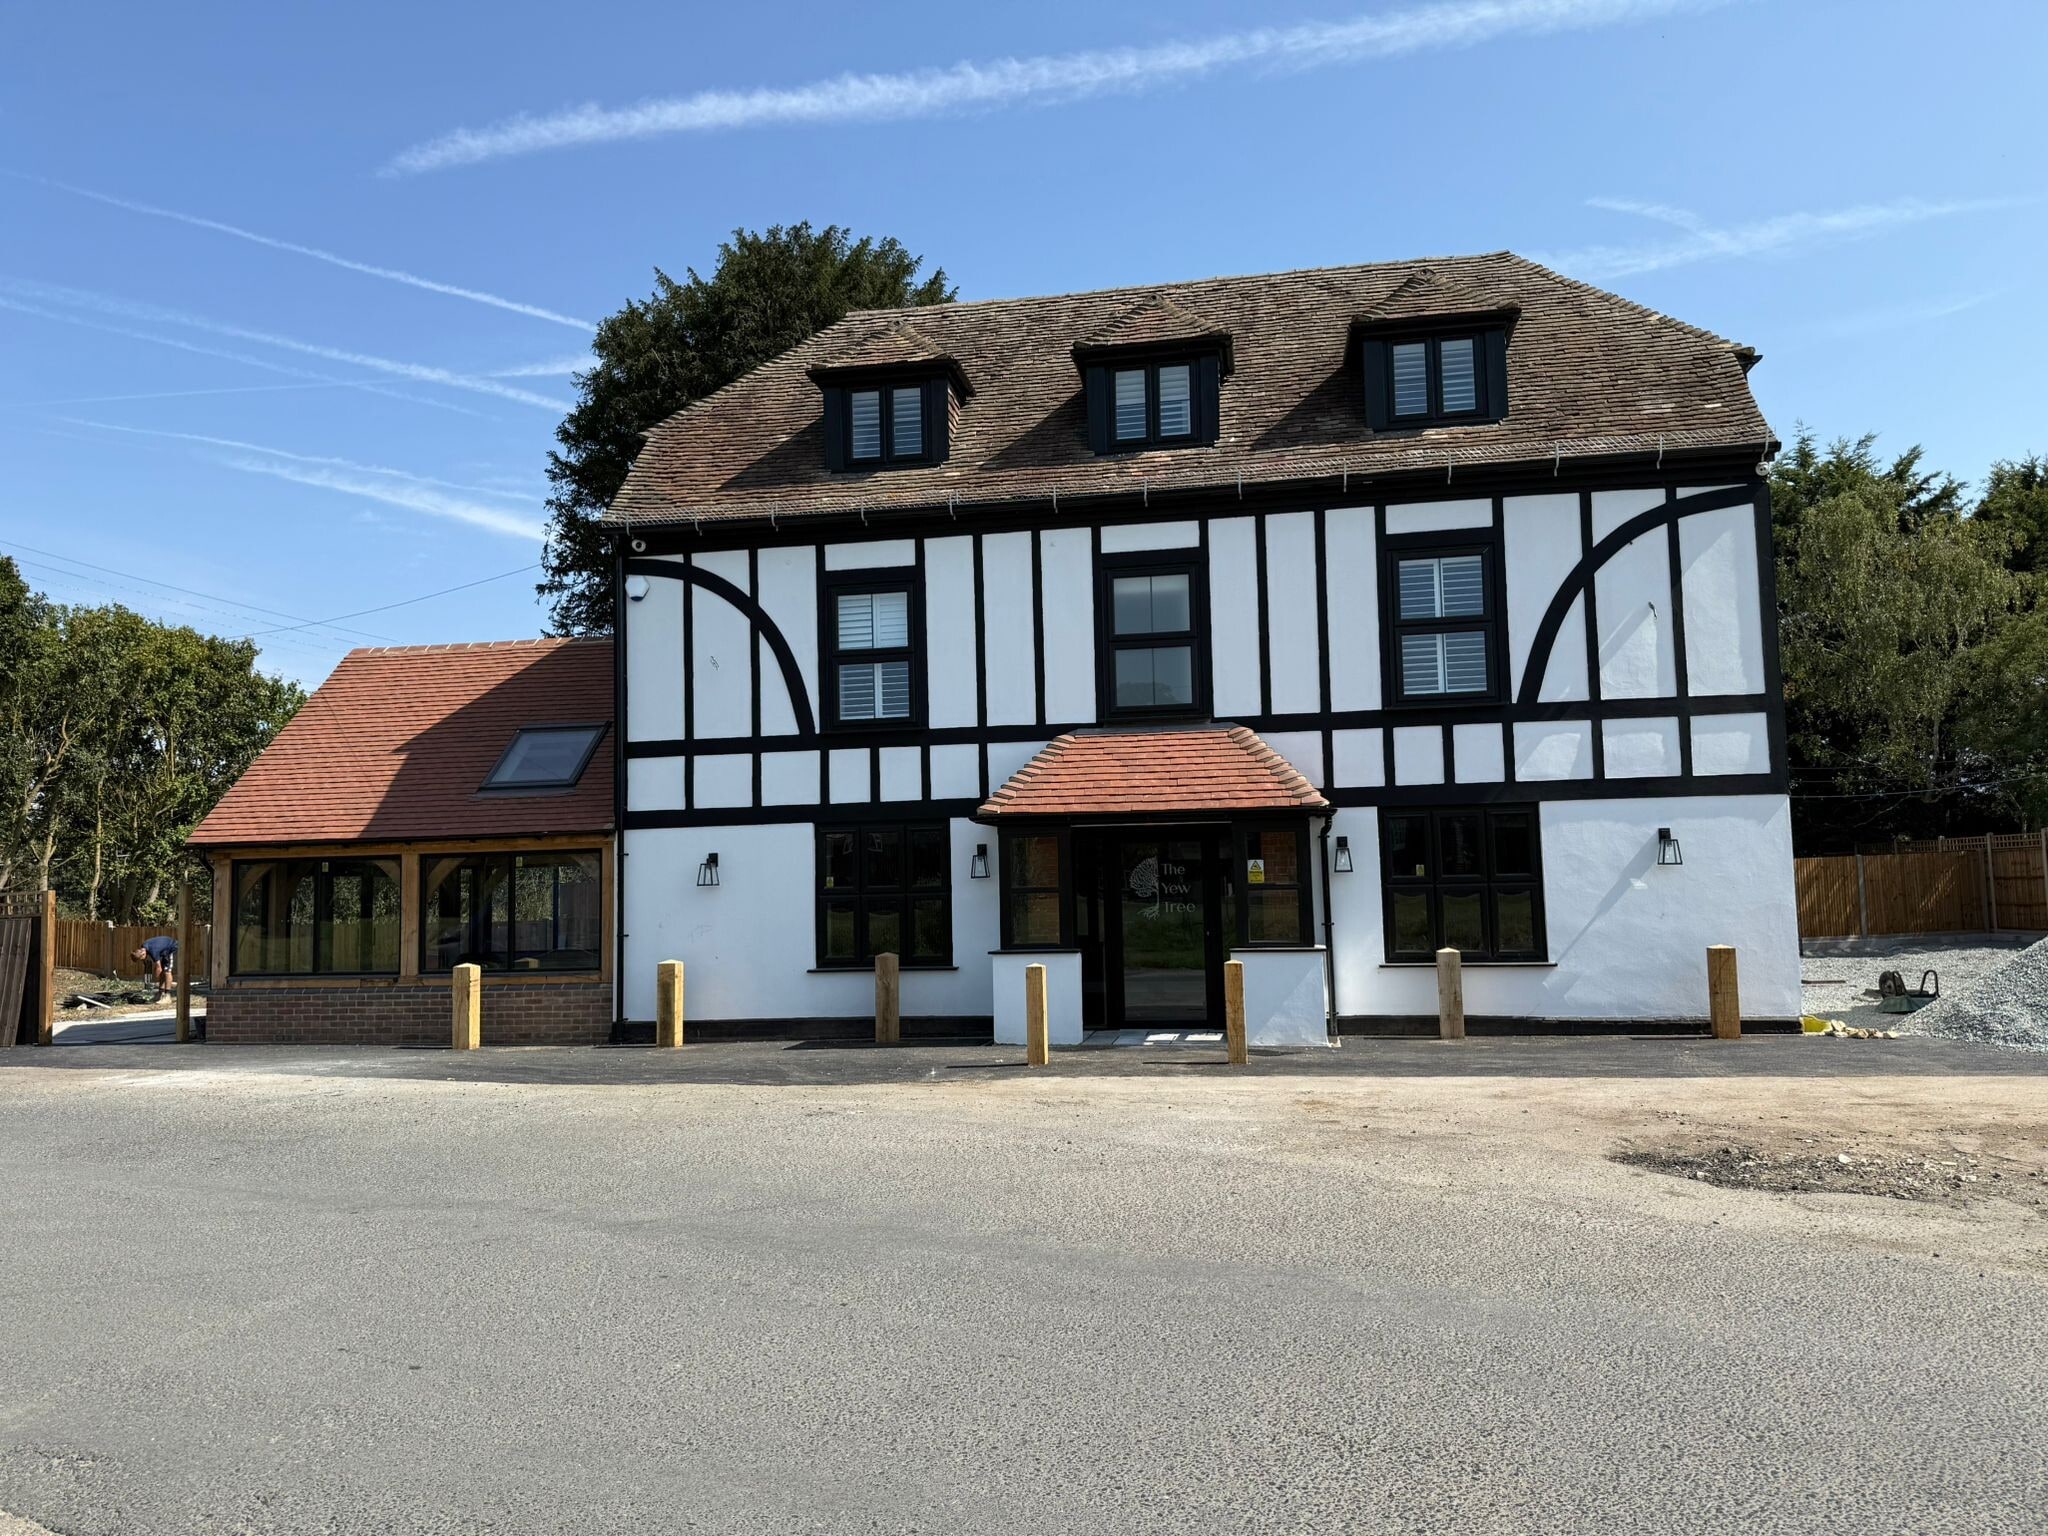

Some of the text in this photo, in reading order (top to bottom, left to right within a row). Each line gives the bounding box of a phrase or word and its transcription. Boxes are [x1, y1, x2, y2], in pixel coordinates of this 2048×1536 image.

[1161, 863, 1186, 875] The
[1161, 882, 1191, 894] Yew
[1162, 901, 1196, 913] Tree
